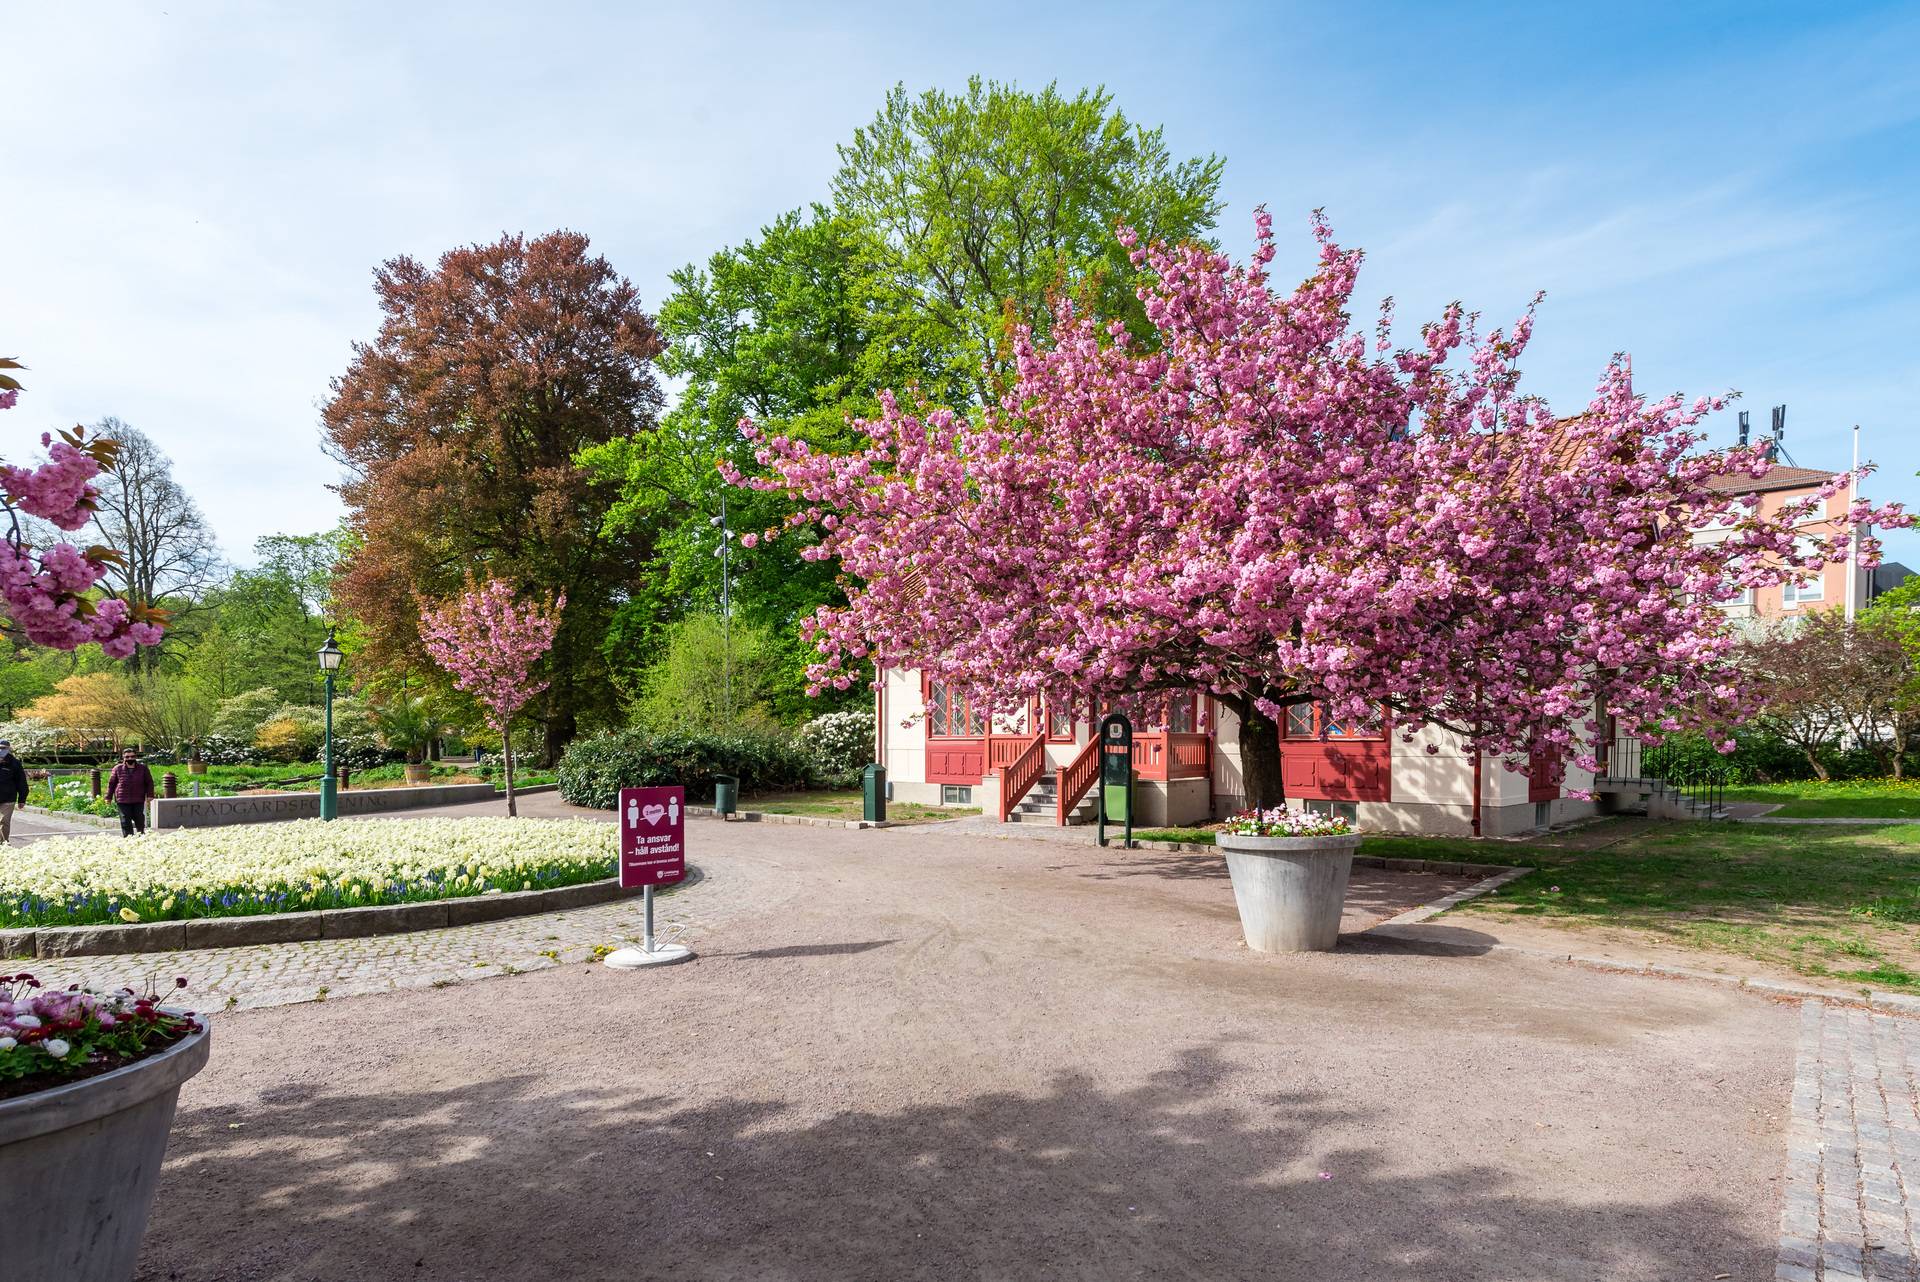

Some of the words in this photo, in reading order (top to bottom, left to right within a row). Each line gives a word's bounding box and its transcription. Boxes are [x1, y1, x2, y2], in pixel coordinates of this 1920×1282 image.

[636, 835, 645, 844] Ta
[647, 834, 672, 844] ansvar
[635, 845, 649, 855] håll
[650, 843, 680, 854] avstånd!
